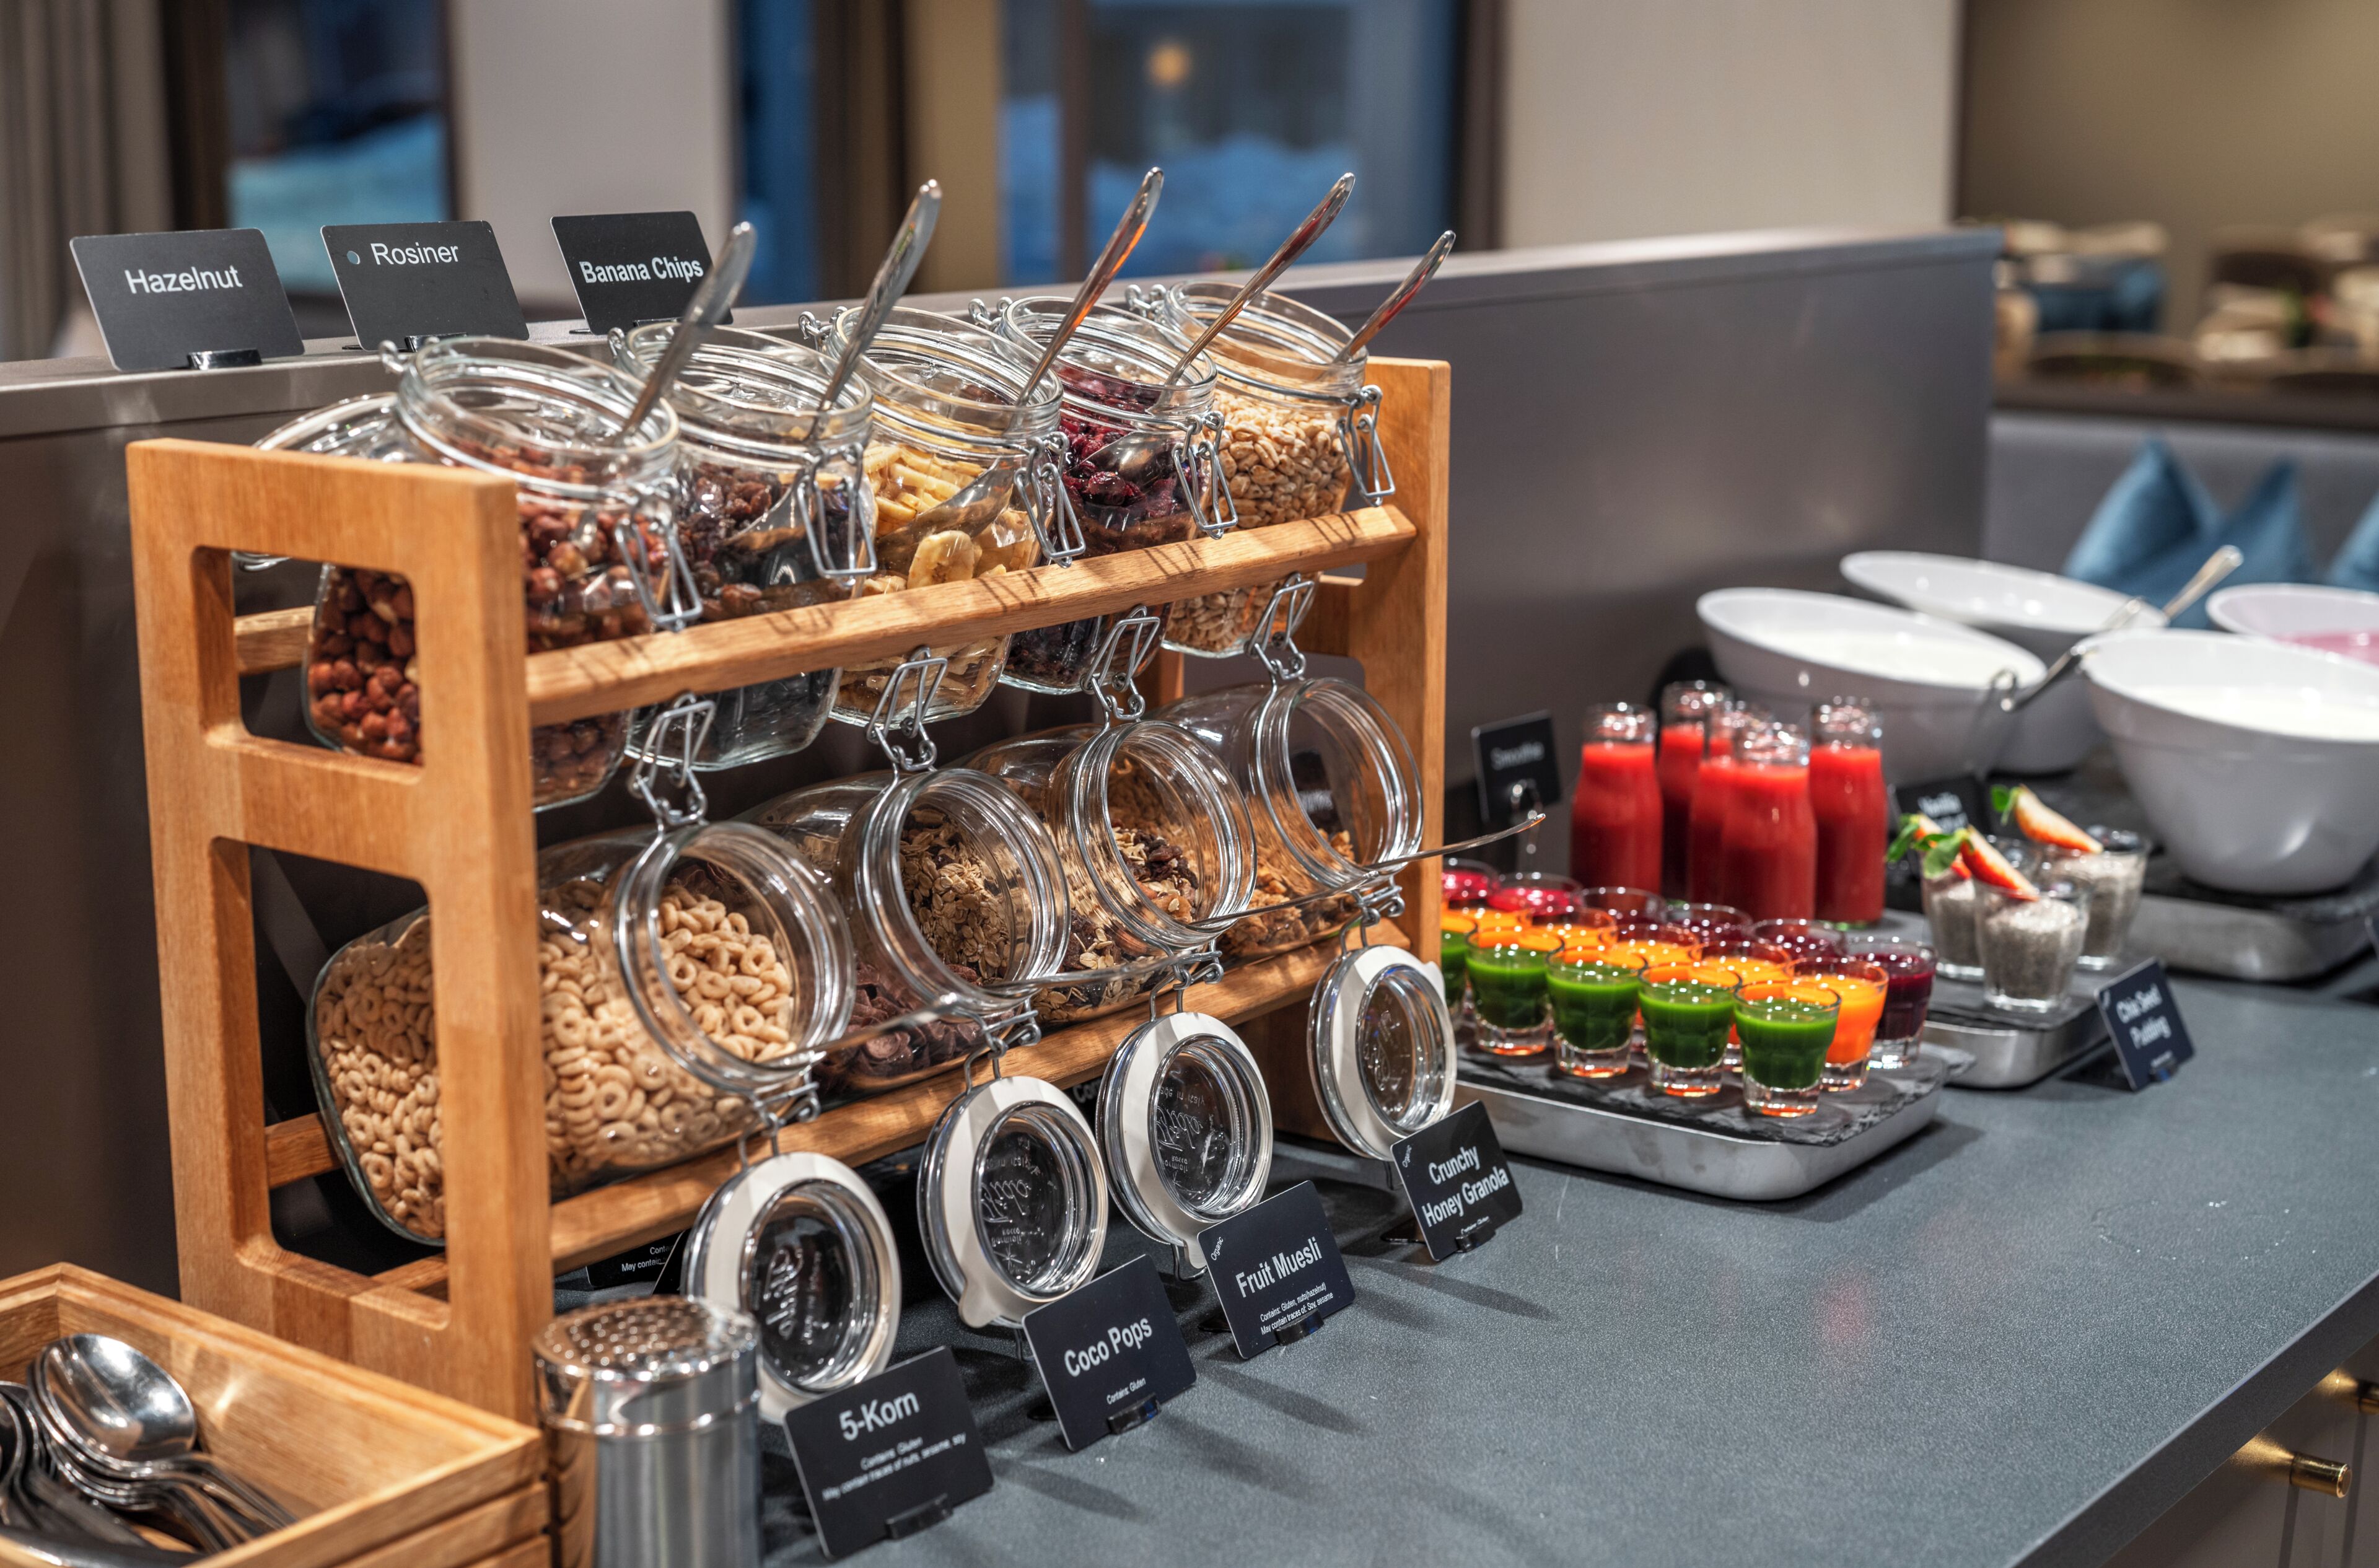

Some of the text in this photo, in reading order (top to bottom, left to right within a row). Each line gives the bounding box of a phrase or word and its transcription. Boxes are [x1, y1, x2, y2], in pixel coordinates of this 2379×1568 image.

[370, 242, 458, 265] Rosiner
[125, 265, 243, 294] Hazelnut
[579, 256, 704, 283] Banana Chips
[1428, 1146, 1481, 1185] Crunchy
[1422, 1166, 1510, 1227] Honey Granola
[1211, 1236, 1224, 1261] Organic
[621, 1263, 636, 1272] May
[1235, 1236, 1323, 1298] Fruit Muesli
[1260, 1325, 1271, 1336] May
[1271, 1316, 1288, 1330] contain
[1287, 1309, 1302, 1321] traces
[1317, 1292, 1333, 1306] sesame
[1260, 1307, 1282, 1322] Contains:
[1064, 1318, 1152, 1377] Coco Pops
[1129, 1377, 1146, 1392] Gluten
[839, 1392, 920, 1440] 5-Korn
